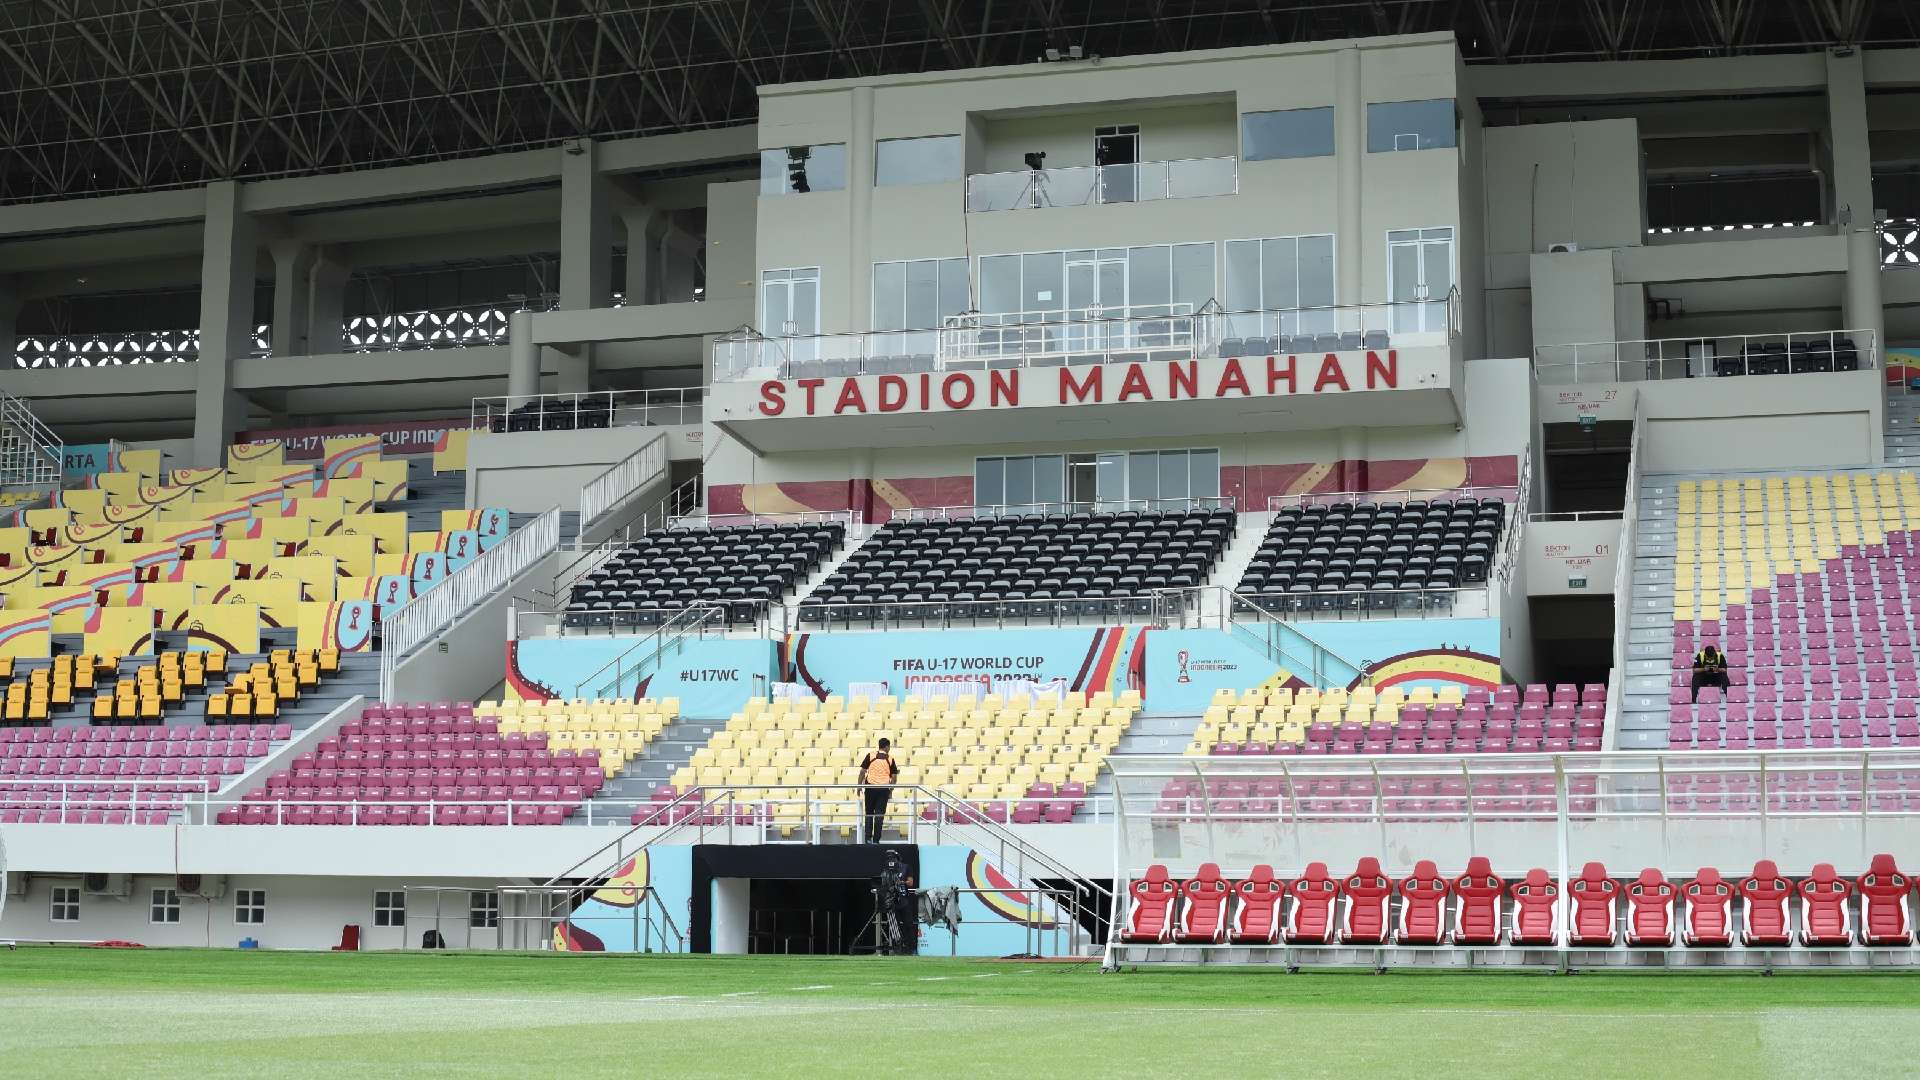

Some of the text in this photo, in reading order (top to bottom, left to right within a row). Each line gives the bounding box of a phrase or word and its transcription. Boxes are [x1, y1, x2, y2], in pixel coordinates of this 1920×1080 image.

[759, 350, 1398, 416] STADION MANAHAN
[1604, 390, 1617, 400] 27
[1595, 544, 1609, 555] 01
[893, 656, 1043, 671] FIFA U-17 WORLD CUP
[680, 669, 739, 682] #U17WC
